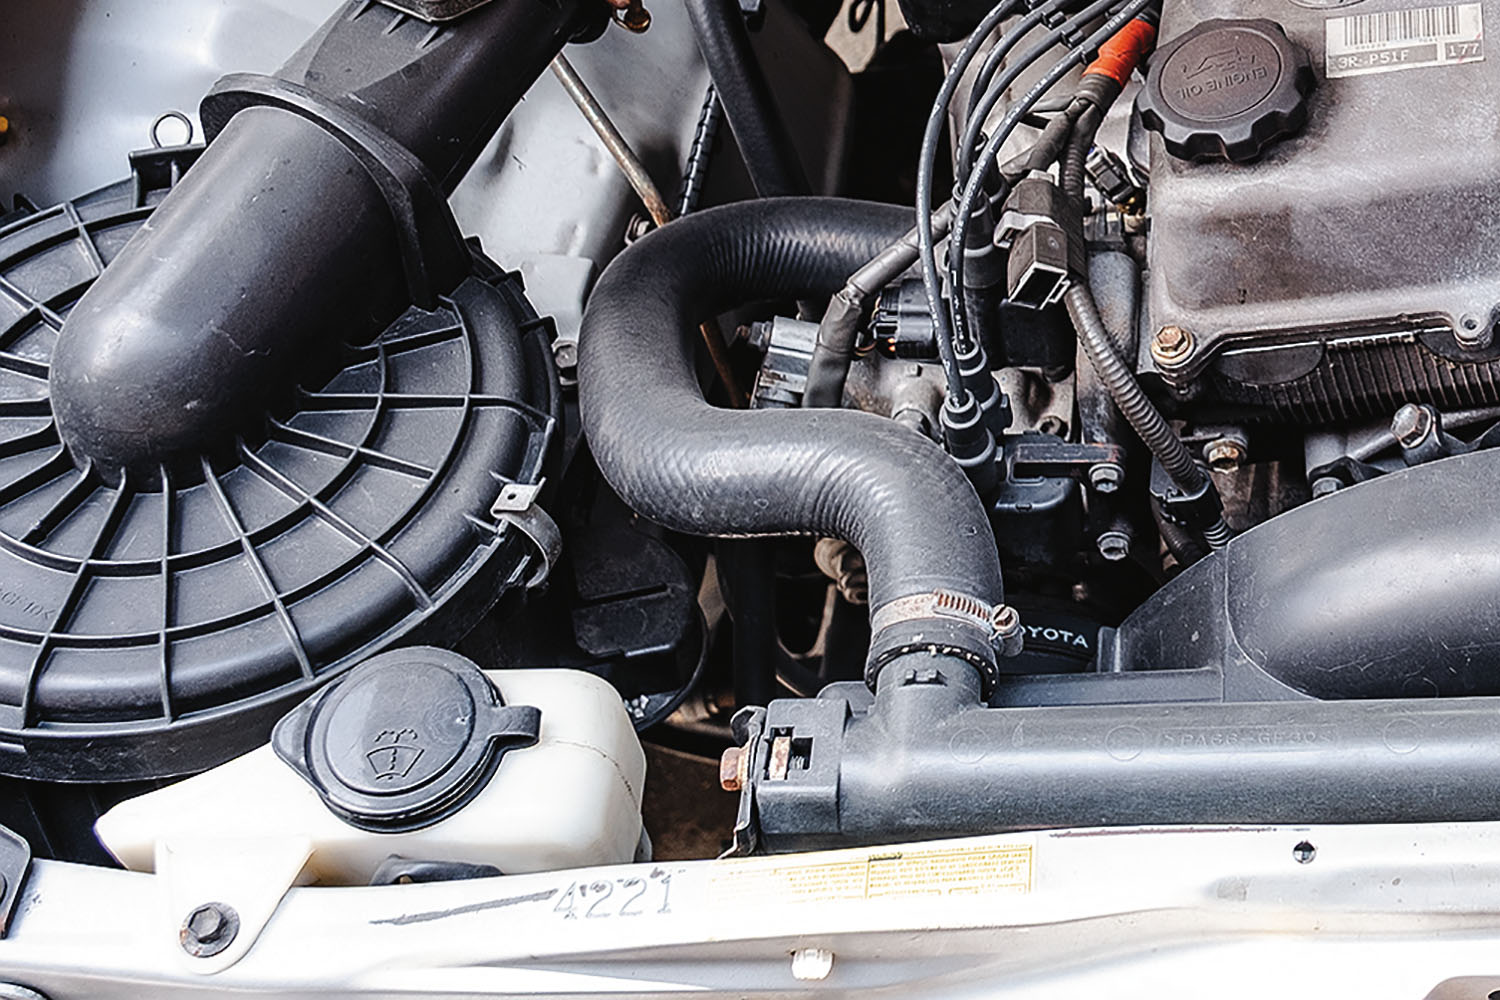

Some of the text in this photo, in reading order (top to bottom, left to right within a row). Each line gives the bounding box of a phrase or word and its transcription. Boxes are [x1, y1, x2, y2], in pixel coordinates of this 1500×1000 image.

[1449, 43, 1479, 57] 177
[1175, 66, 1268, 99] ENGINE OIL
[1020, 625, 1088, 648] YOTA
